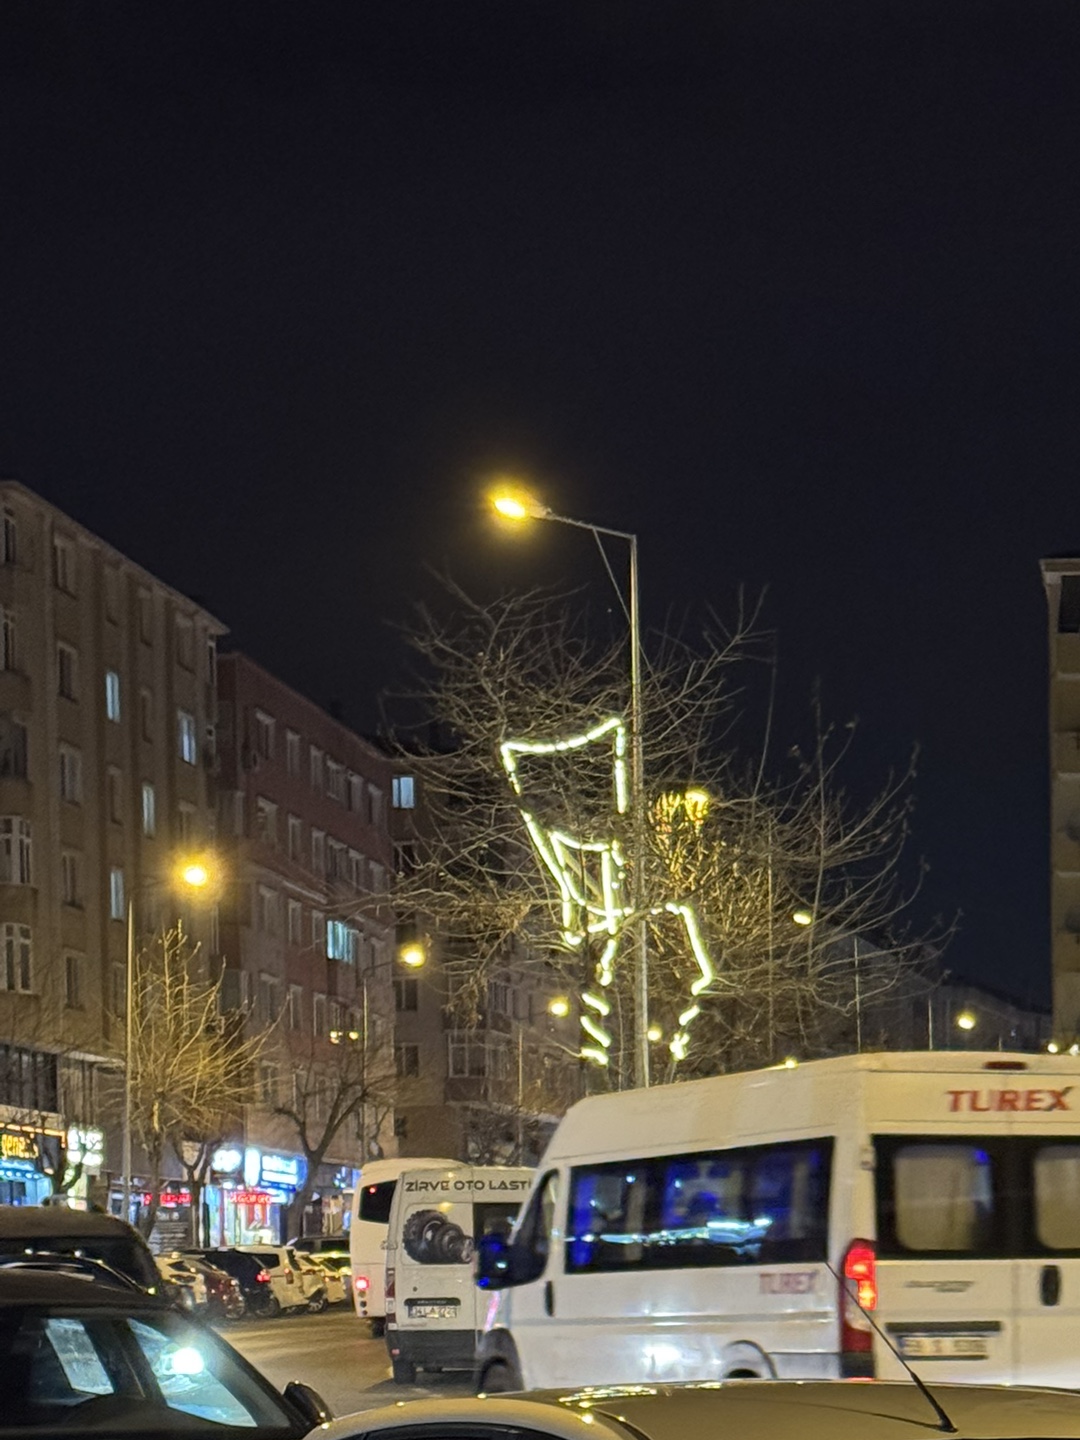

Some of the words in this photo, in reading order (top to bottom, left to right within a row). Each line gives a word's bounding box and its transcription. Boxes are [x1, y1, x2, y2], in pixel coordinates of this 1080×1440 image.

[946, 1086, 1077, 1113] TUREX
[405, 1180, 450, 1192] ZİRVE
[454, 1180, 485, 1190] OTO
[489, 1180, 532, 1191] LASTİ
